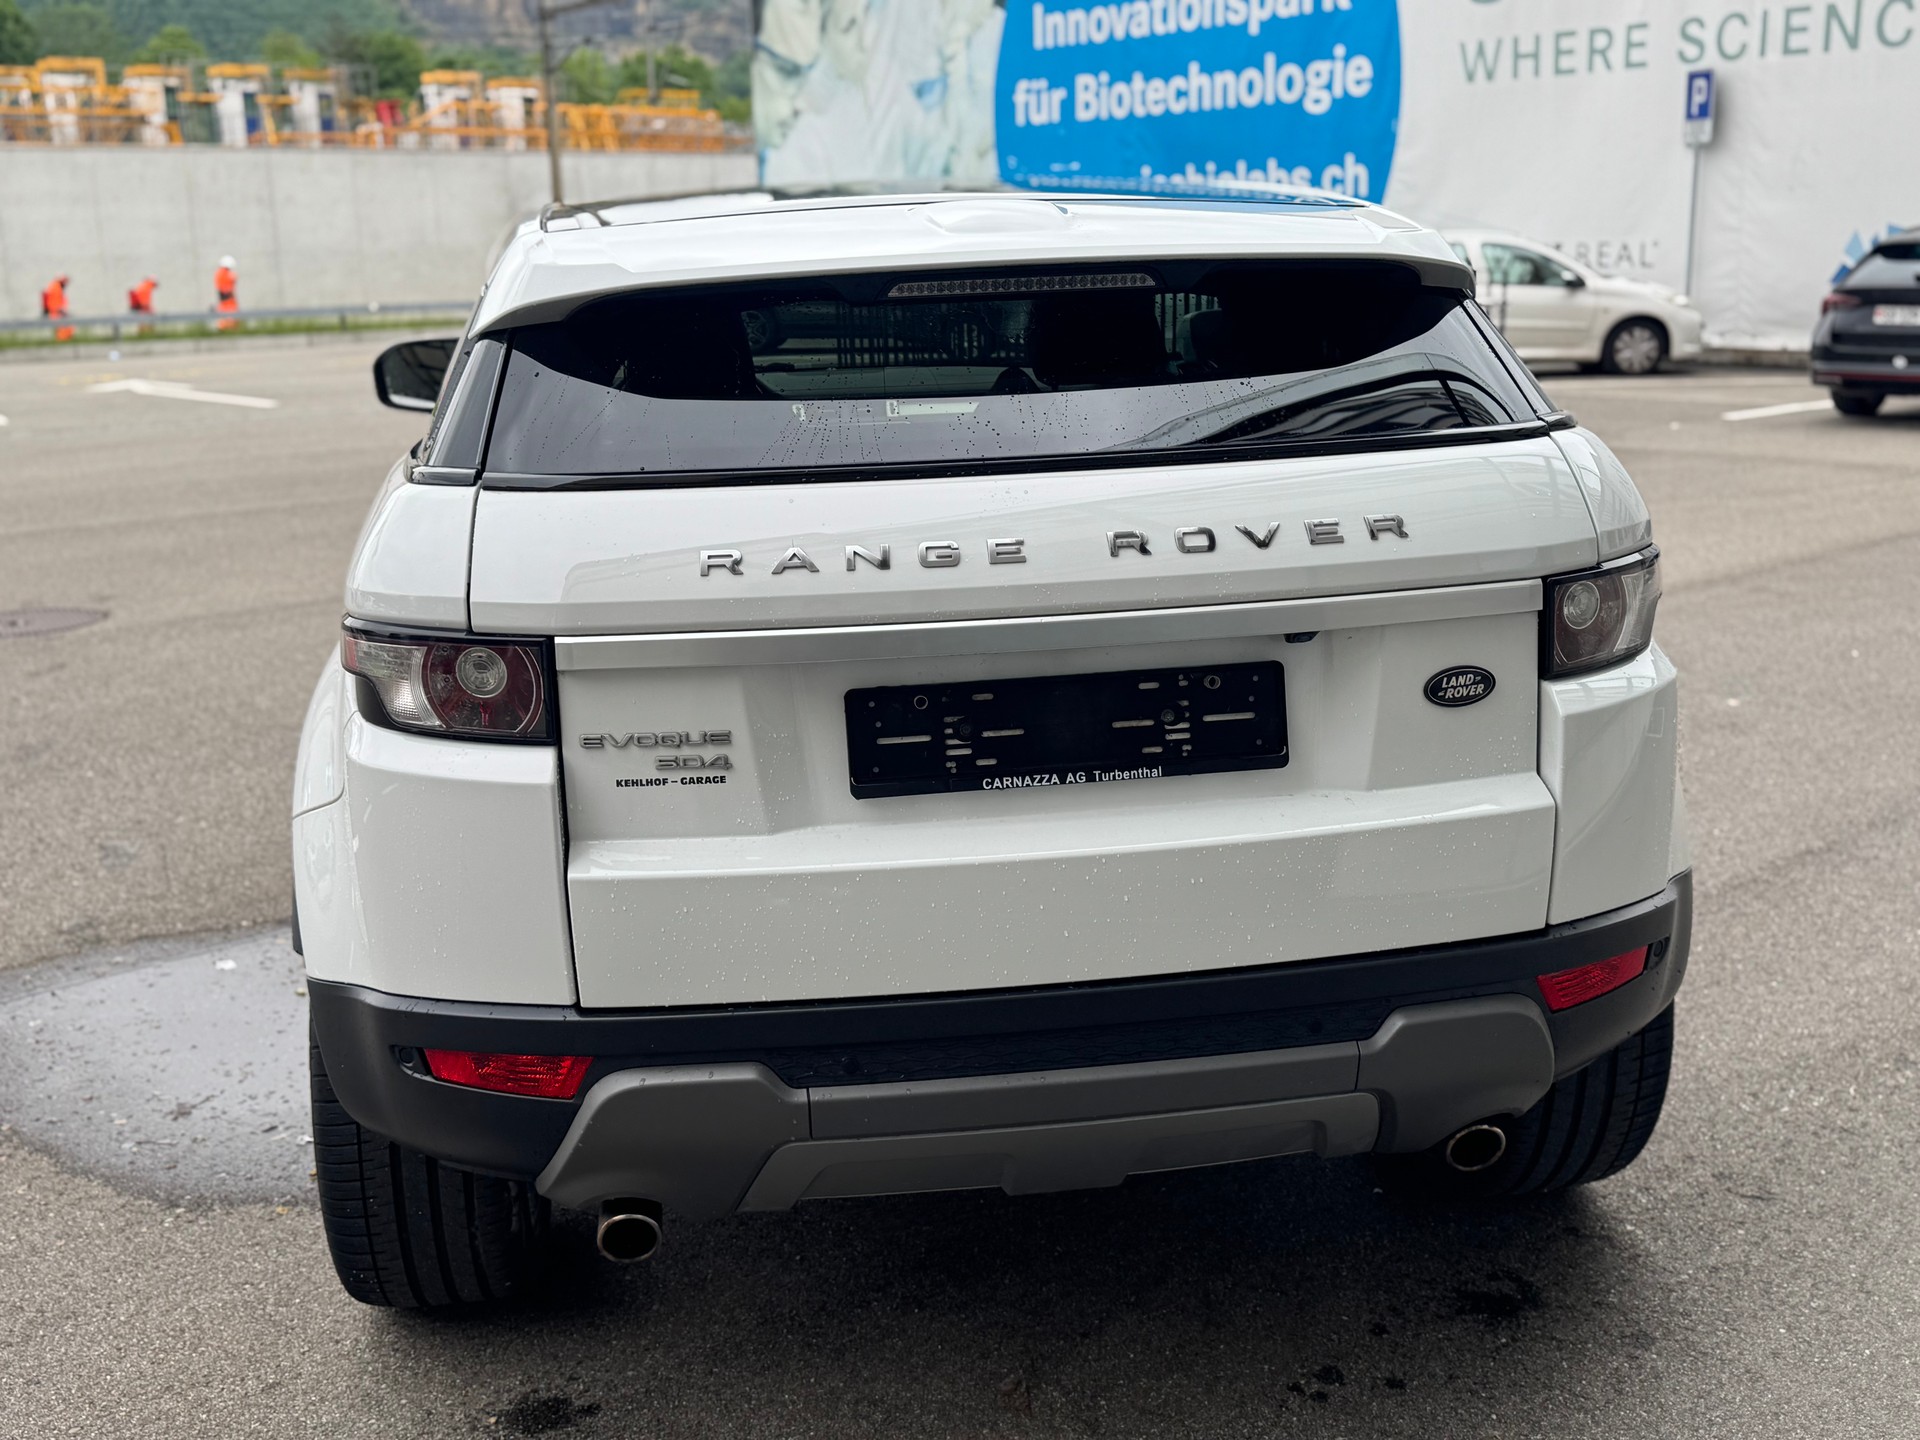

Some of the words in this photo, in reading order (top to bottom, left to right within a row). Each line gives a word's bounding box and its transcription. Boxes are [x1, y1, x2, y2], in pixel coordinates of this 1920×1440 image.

[1032, 0, 1352, 50] Innovationspa
[1460, 22, 1649, 83] WHERE
[1677, 0, 1914, 63] SCIENC
[1013, 77, 1068, 127] für
[1074, 43, 1374, 122] Biotechnologie
[1690, 77, 1708, 117] P
[699, 537, 1028, 577] RANGE
[1105, 513, 1410, 557] ROVER
[1445, 683, 1485, 699] ROVER
[579, 729, 732, 749] EVOQUE
[654, 753, 733, 770] SD4
[982, 773, 1061, 790] CARNAZZA
[1065, 771, 1086, 784] AG
[1093, 765, 1162, 782] Turbenthal
